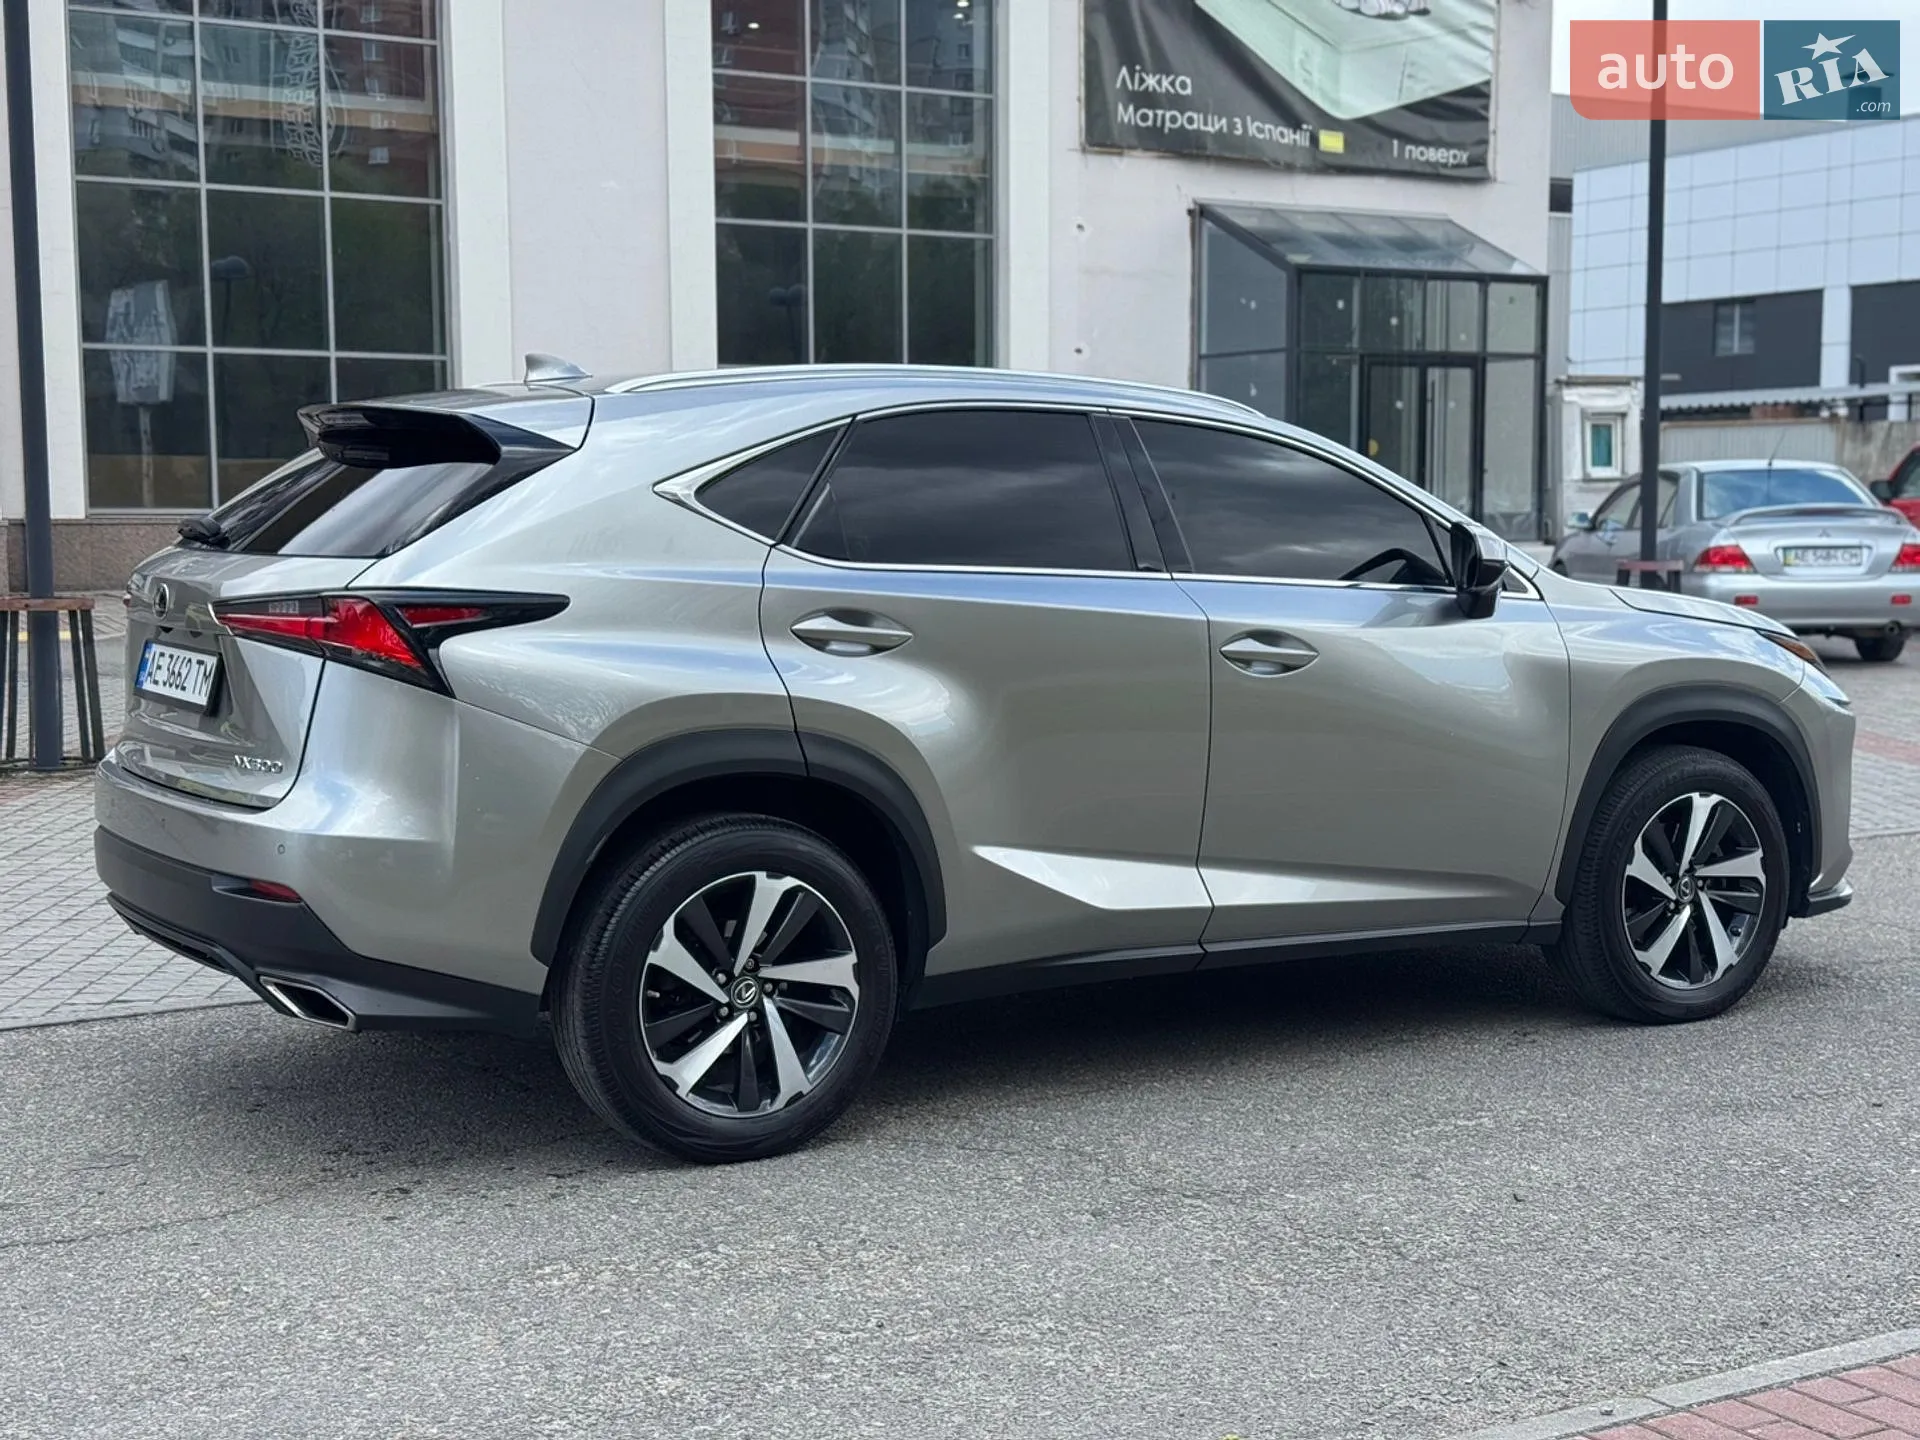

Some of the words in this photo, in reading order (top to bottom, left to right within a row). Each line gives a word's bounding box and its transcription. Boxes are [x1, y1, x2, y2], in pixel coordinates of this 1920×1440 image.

[1116, 65, 1192, 95] Ліжка
[1117, 102, 1228, 134] Матраци
[1233, 118, 1243, 136] з
[1248, 115, 1313, 148] Іспанії
[1404, 144, 1469, 168] поверх
[145, 650, 165, 686] AE
[162, 653, 192, 692] 3662
[192, 659, 215, 698] TM
